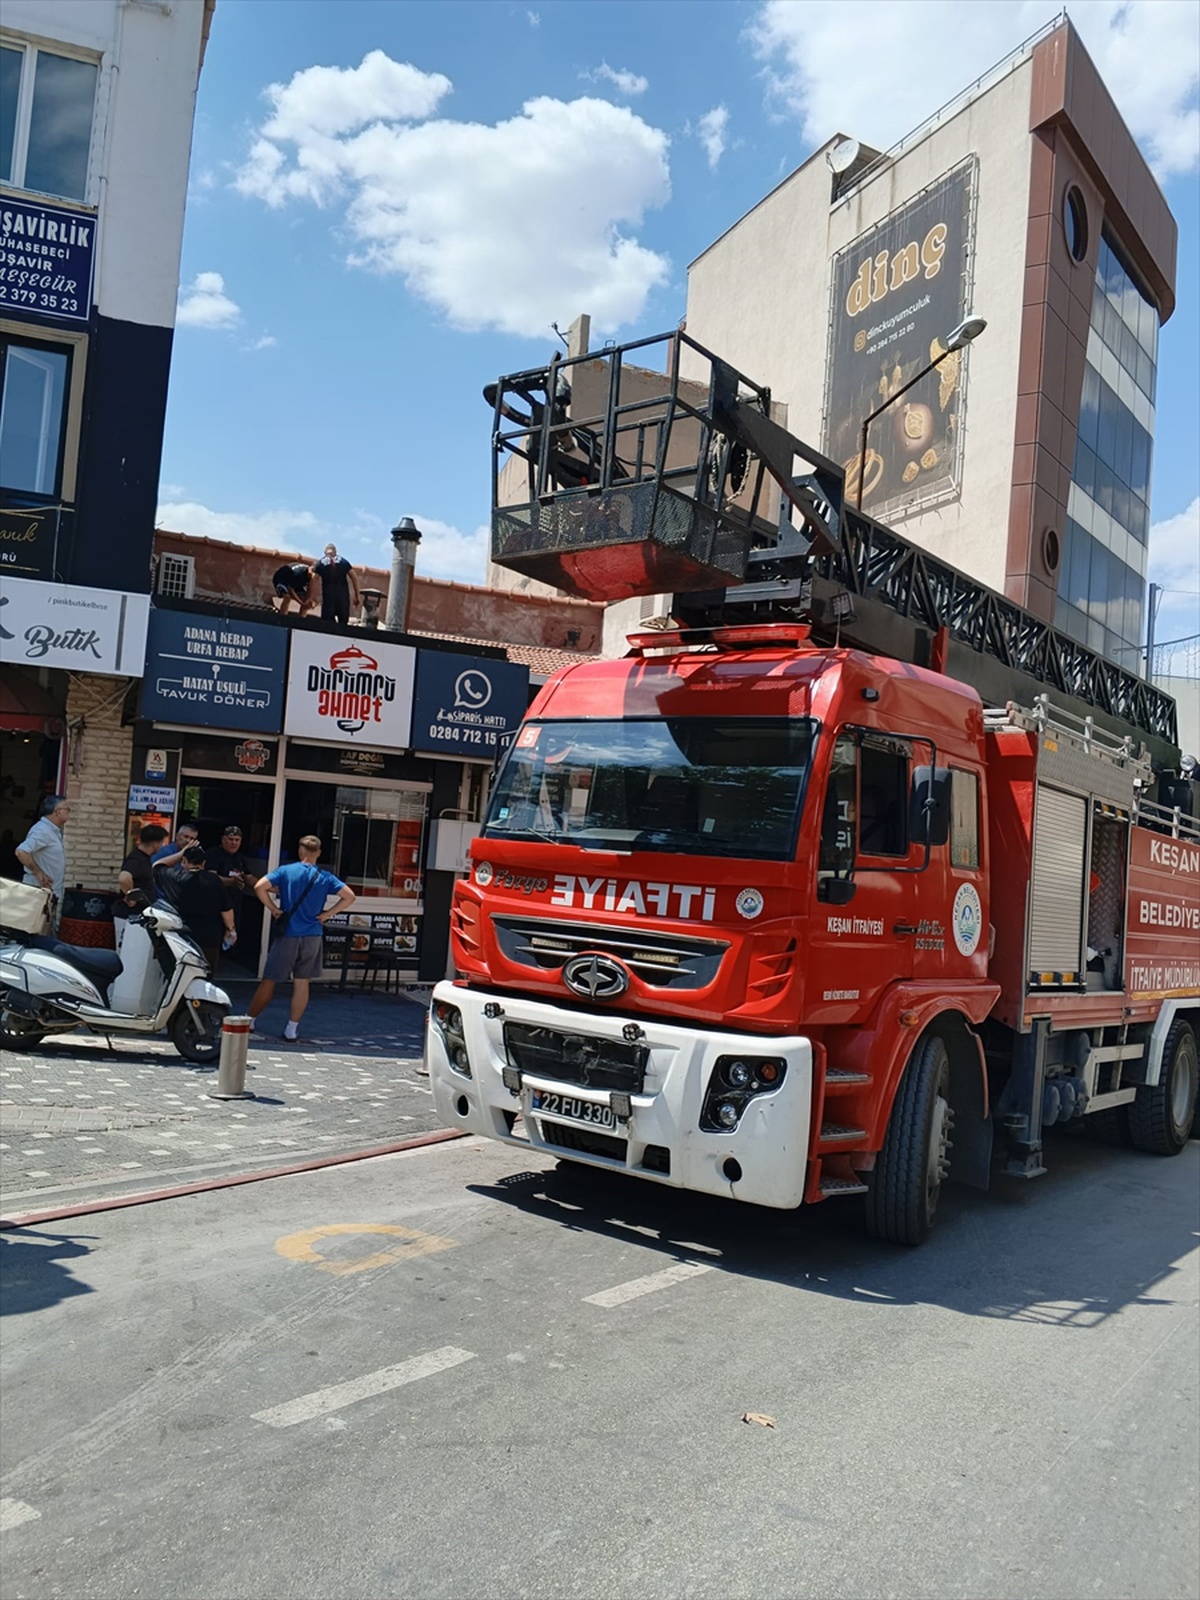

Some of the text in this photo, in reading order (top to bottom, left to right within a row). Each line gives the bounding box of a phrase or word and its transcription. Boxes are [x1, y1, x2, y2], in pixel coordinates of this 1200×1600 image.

[0, 210, 90, 248] ŞAVİRLİK
[846, 223, 948, 318] dinç
[11, 288, 37, 304] 379
[40, 293, 57, 307] 35
[61, 298, 78, 311] 23
[24, 624, 102, 659] Butik
[184, 626, 254, 648] ADANA KEBAP
[186, 641, 249, 660] URFA KEBAP
[182, 676, 247, 695] HATAY USULÜ
[160, 688, 266, 709] TAVUK DÖNER
[429, 724, 460, 741] 0284
[462, 728, 482, 744] 712
[485, 731, 497, 745] 15
[522, 730, 535, 745] 5
[1149, 838, 1200, 876] KEŞAN
[493, 869, 548, 895] Fargo
[827, 916, 852, 937] KEŞAN
[1130, 959, 1162, 990] İTFAİYE
[541, 1092, 613, 1126] 22 FU 330
